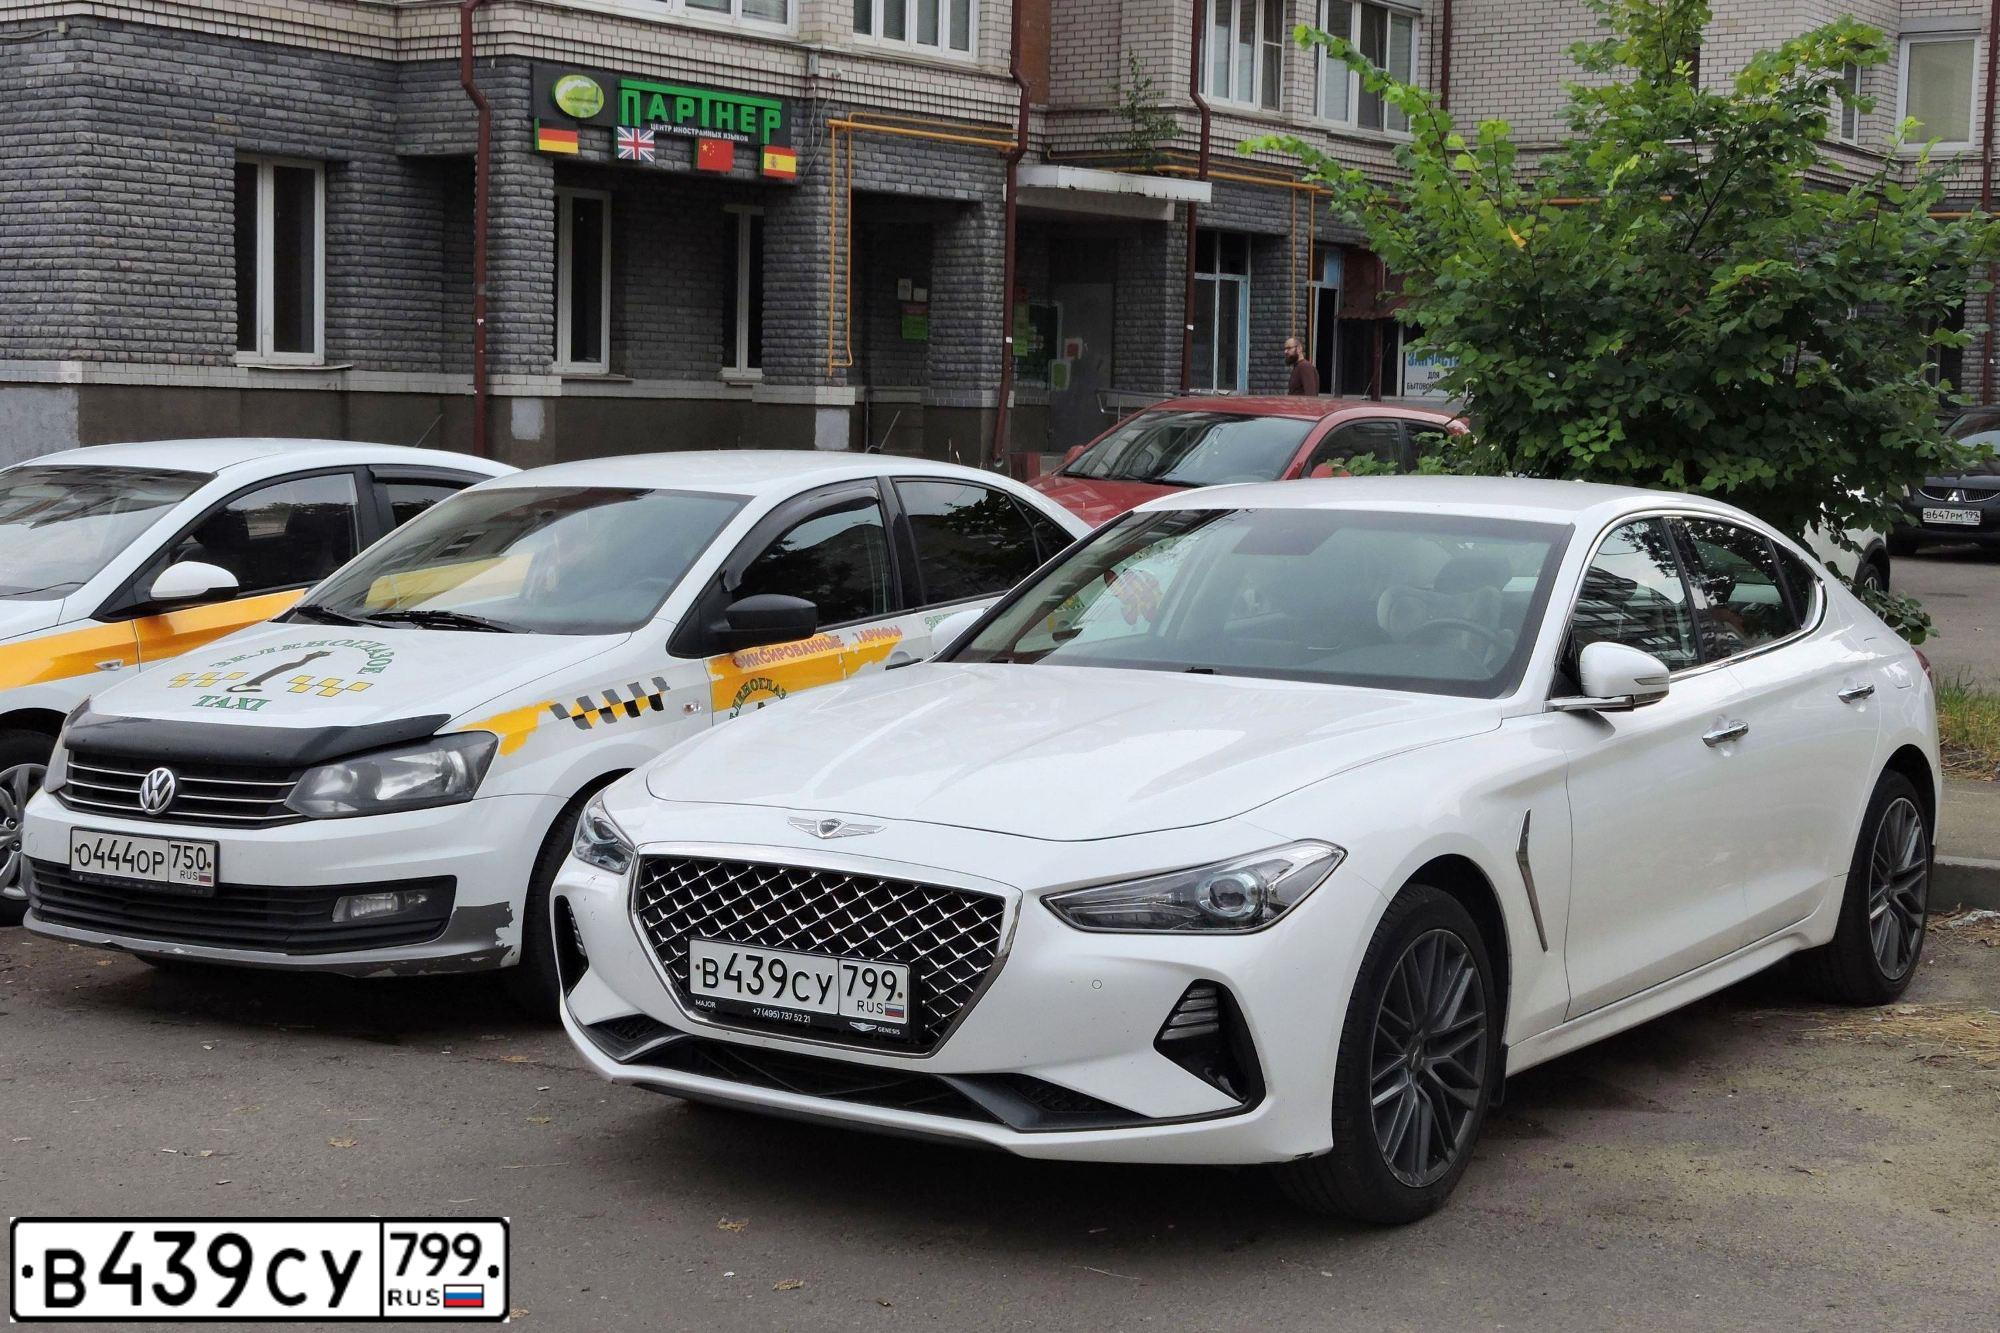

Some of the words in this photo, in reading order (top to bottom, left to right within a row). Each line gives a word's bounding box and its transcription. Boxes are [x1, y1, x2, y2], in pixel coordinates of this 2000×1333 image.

[620, 79, 782, 145] ПАРТНЕР
[650, 123, 672, 133] ЦЕНТР
[673, 126, 722, 139] ИНОСТРАННЫХ
[723, 132, 748, 142] ЯЗЫКОВ
[193, 695, 272, 711] TAXI
[78, 838, 165, 875] О444ОР
[171, 844, 207, 871] 750
[180, 870, 199, 881] RUS
[702, 952, 833, 1005] В439СУ
[842, 965, 897, 1002] 799
[695, 999, 717, 1009] MAJOR
[857, 1000, 884, 1015] RUS
[781, 1012, 793, 1020] 737
[794, 1014, 803, 1022] 52
[878, 1026, 901, 1035] GENESIS
